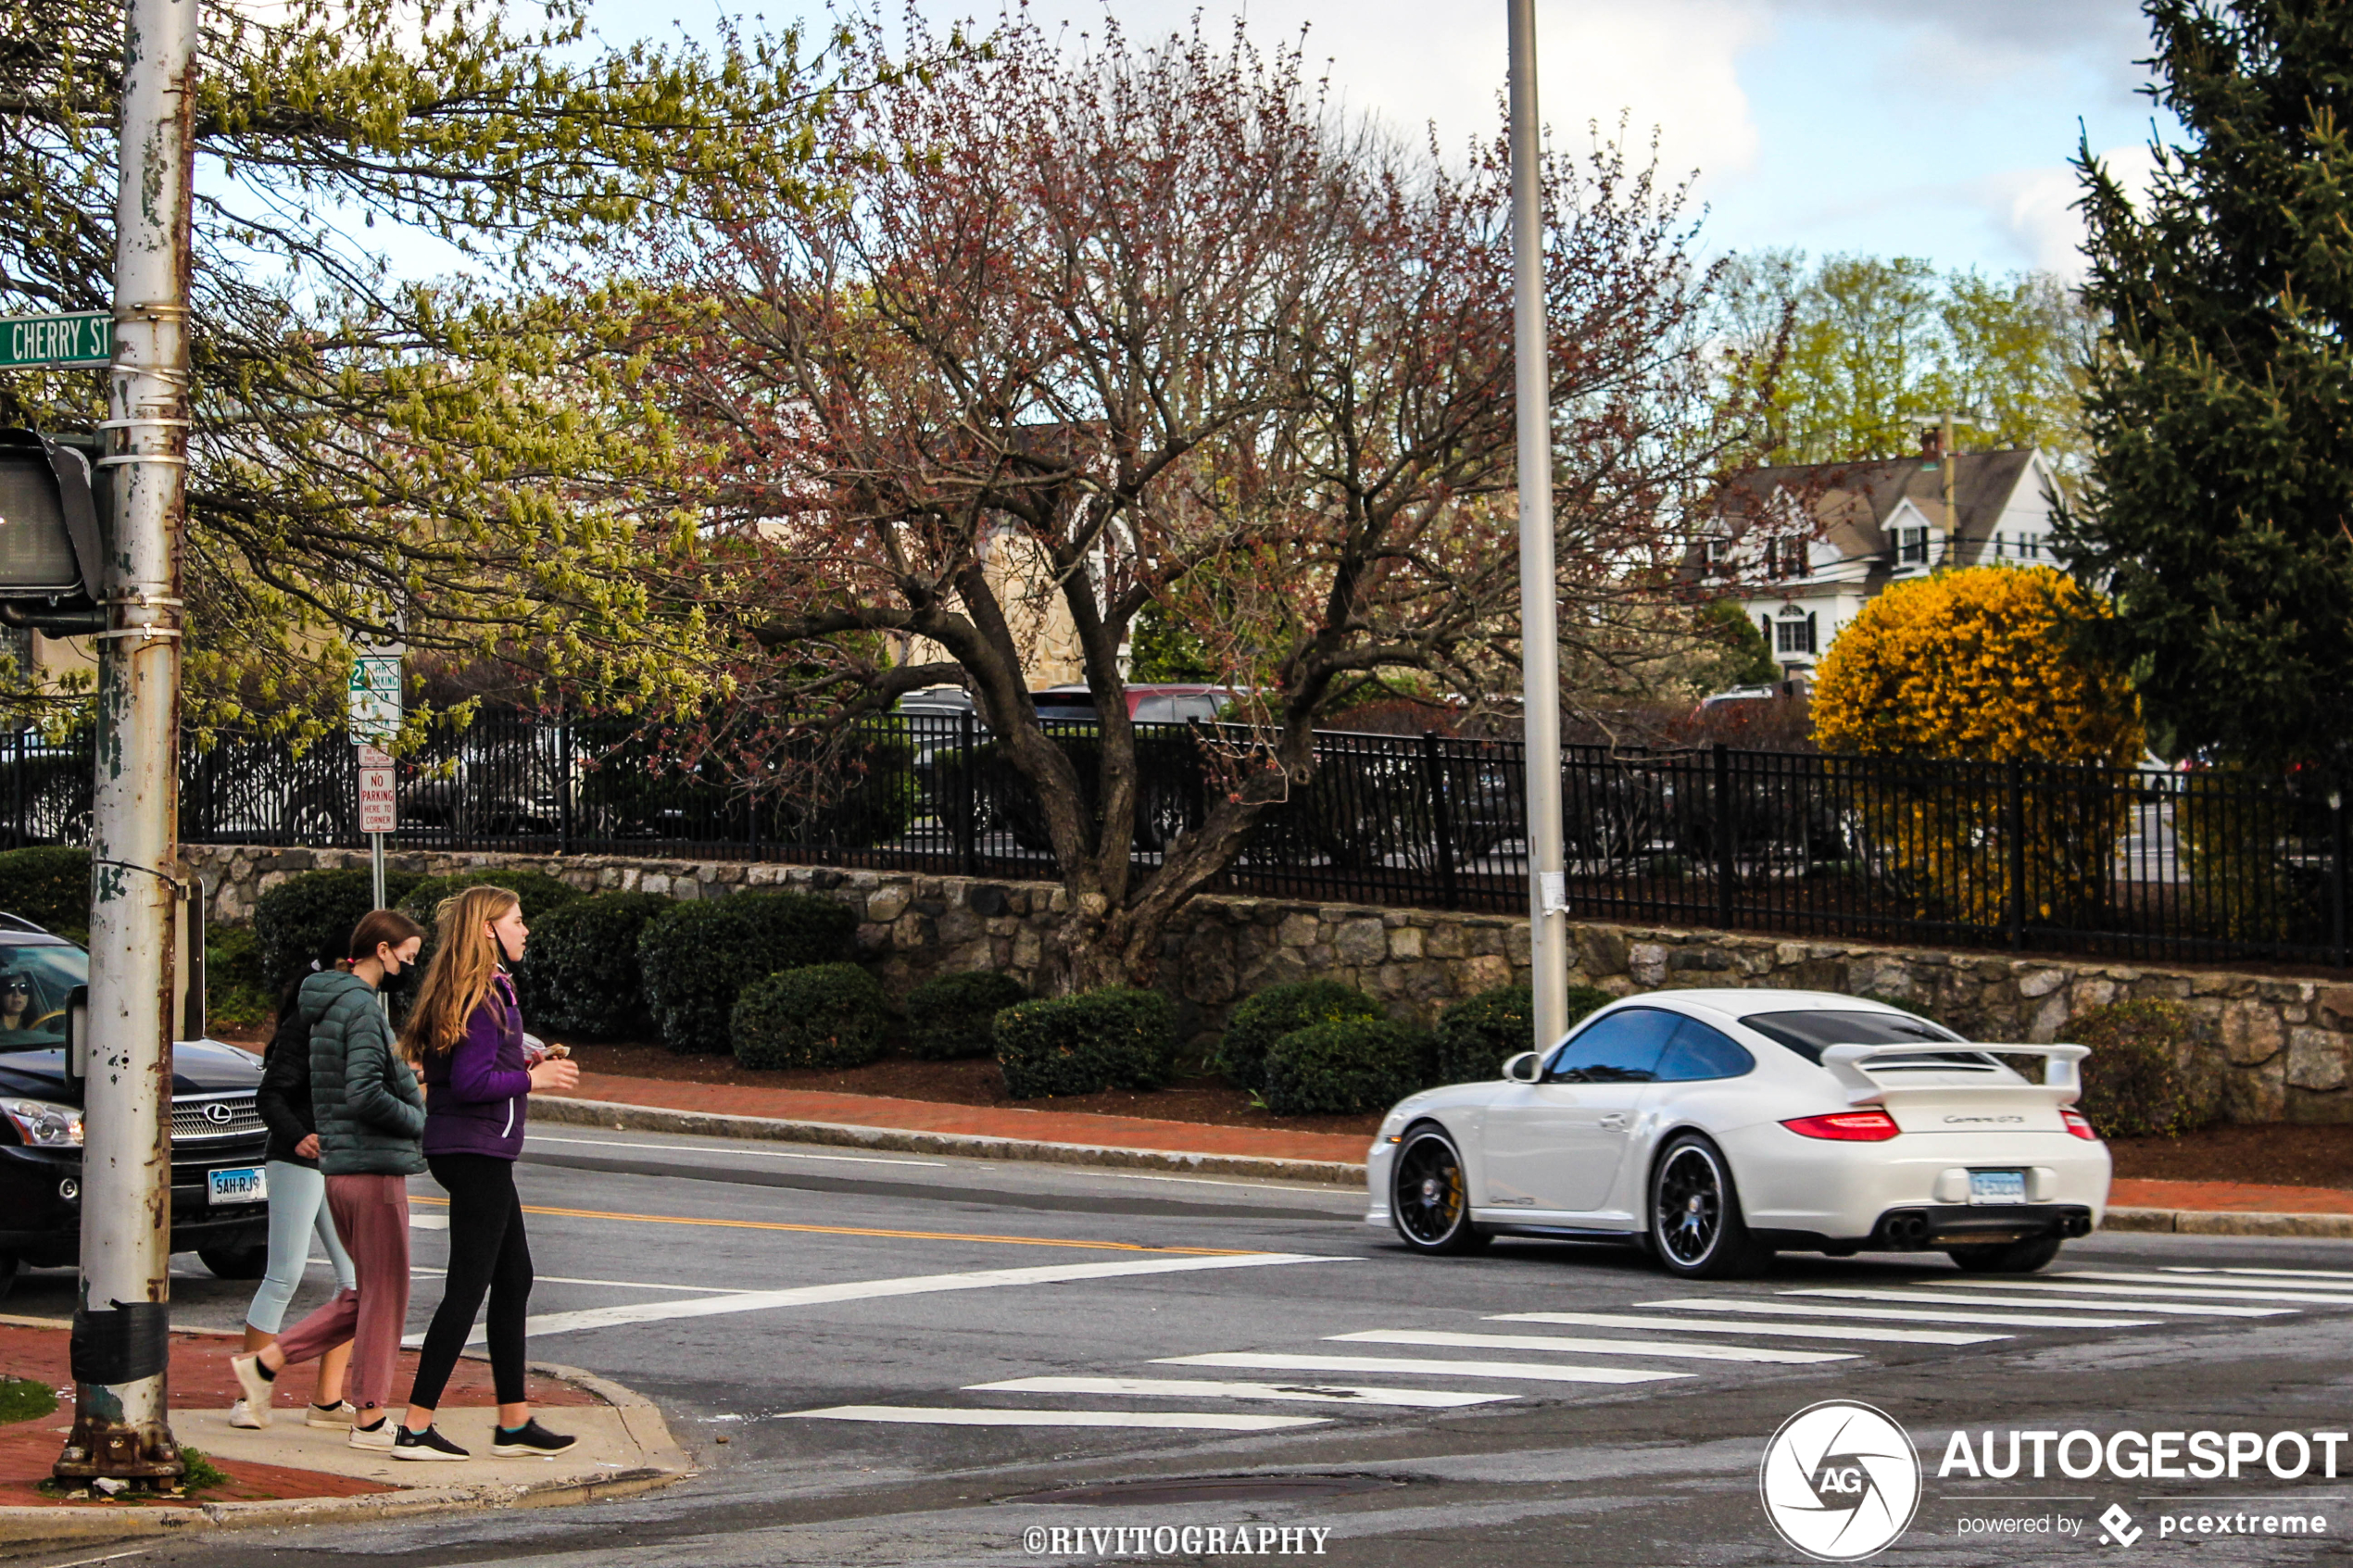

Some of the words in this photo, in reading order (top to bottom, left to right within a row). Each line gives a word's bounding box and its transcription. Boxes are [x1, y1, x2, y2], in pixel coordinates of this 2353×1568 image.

[13, 320, 82, 360] CHERRY
[90, 318, 111, 356] ST
[351, 665, 364, 686] 2
[375, 663, 387, 674] HR
[369, 676, 396, 686] ARKING
[371, 775, 384, 787] NO
[362, 790, 393, 802] PARKING
[364, 805, 380, 813] HERE
[384, 804, 391, 813] TO
[366, 816, 391, 825] CORNER
